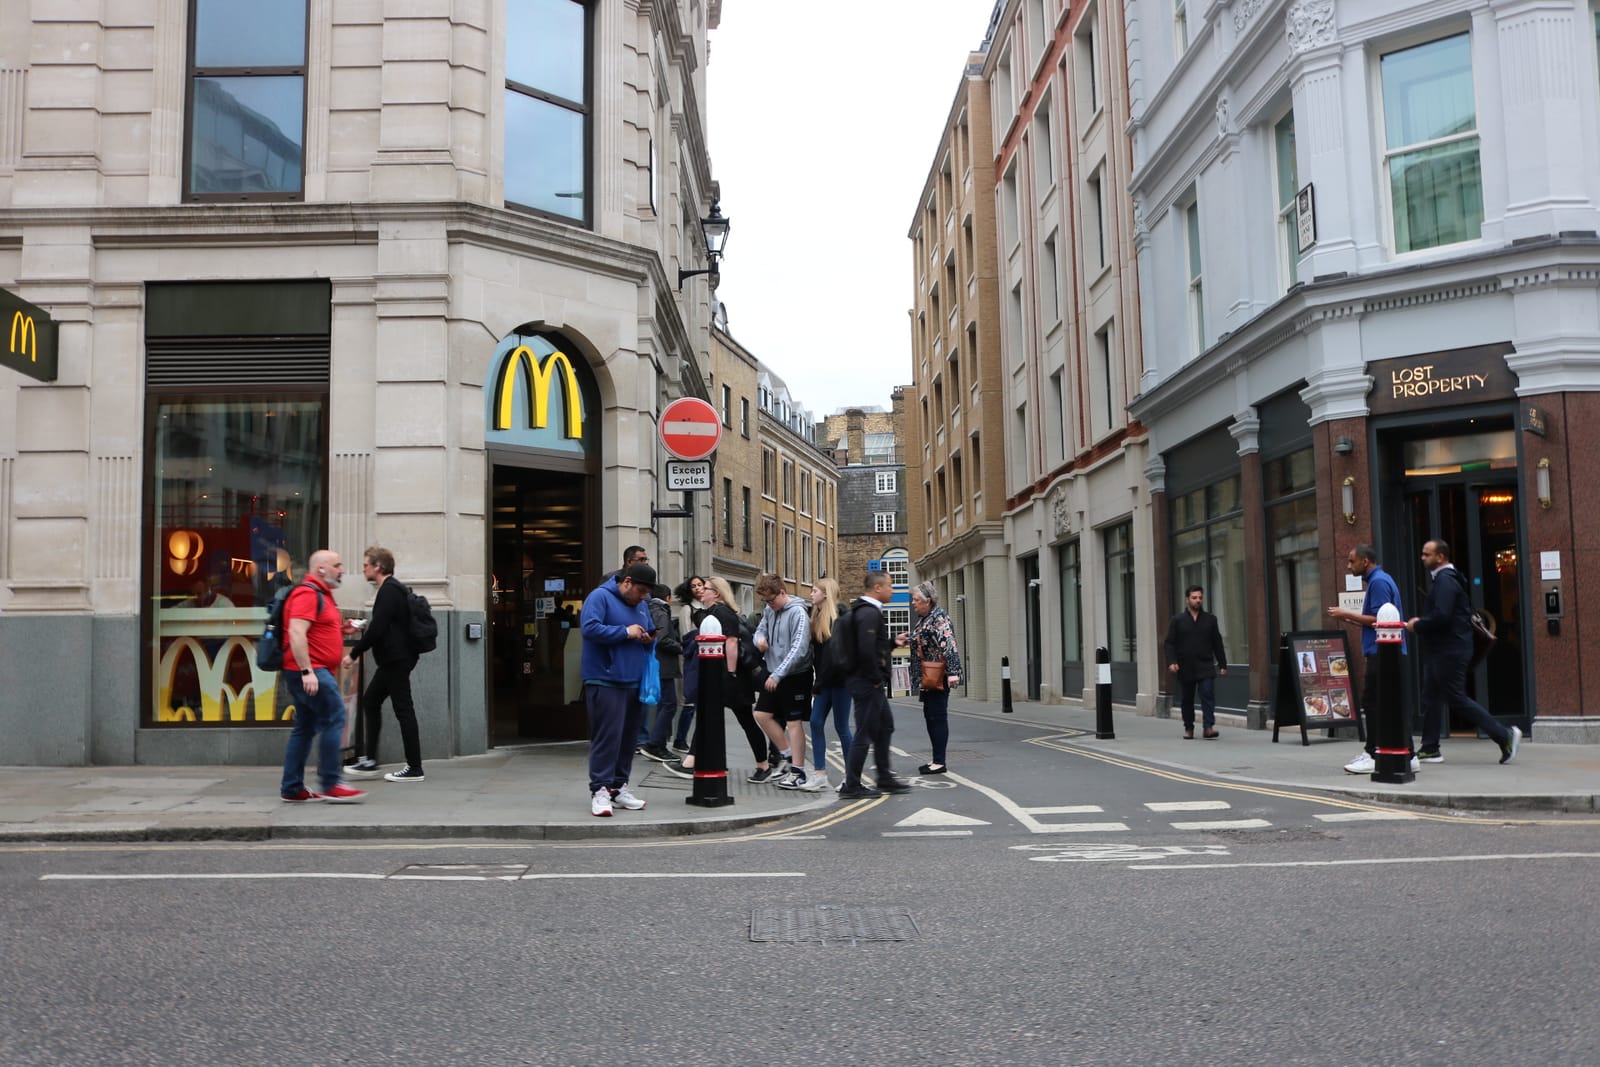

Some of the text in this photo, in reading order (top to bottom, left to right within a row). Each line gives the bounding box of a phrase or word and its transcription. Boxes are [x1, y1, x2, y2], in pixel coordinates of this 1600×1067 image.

[1392, 365, 1434, 384] LOST
[499, 345, 583, 439] M
[1393, 373, 1489, 399] PROPERTY
[672, 466, 706, 475] Except
[674, 476, 705, 486] cycles
